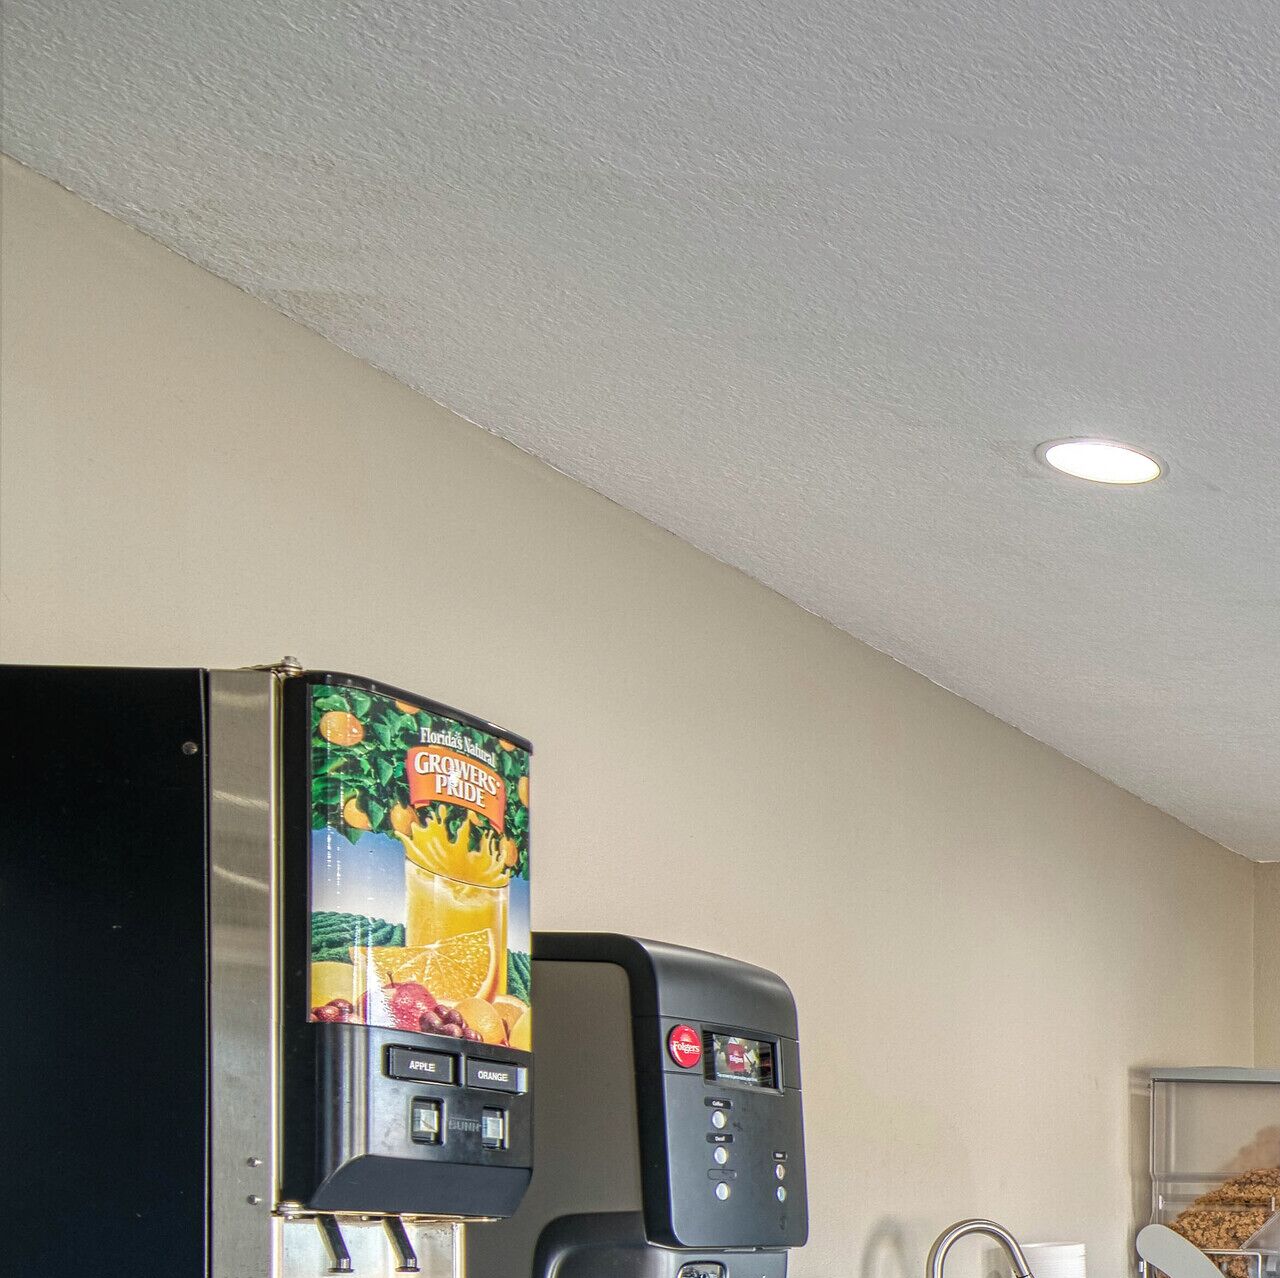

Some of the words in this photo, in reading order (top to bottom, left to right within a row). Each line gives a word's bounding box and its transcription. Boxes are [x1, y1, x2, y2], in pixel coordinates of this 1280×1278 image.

[420, 727, 463, 750] Florida's
[463, 736, 497, 768] Natural
[435, 774, 486, 808] PRIDE
[671, 1040, 700, 1054] Folgers
[408, 1060, 436, 1073] APPLE
[477, 1070, 509, 1082] ORANGE
